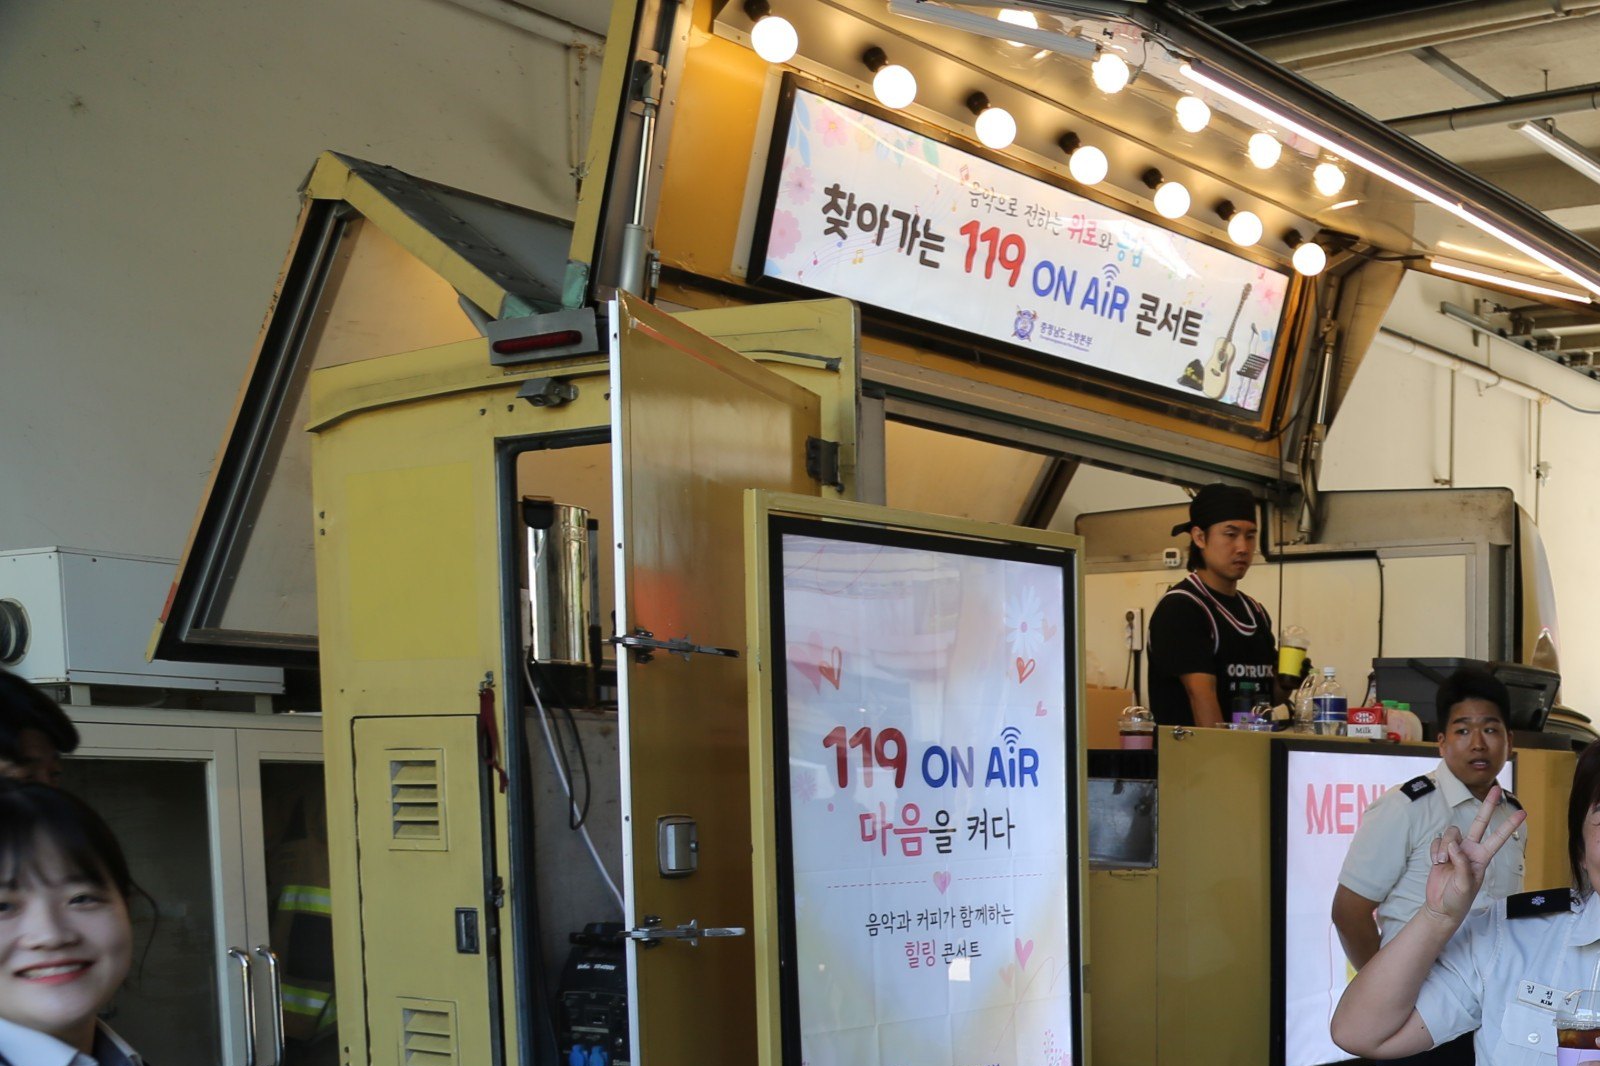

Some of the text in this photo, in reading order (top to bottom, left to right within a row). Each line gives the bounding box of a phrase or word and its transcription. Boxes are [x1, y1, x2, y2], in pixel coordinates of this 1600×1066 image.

[968, 181, 1018, 218] 음악으로
[1024, 203, 1063, 236] 전하는
[1067, 213, 1113, 252] 위로와
[822, 183, 946, 270] 찾아가는
[959, 219, 1026, 288] 119
[1032, 260, 1078, 306] ON
[1136, 293, 1204, 347] 콘서트
[822, 726, 908, 789] 119
[921, 745, 974, 788] ON
[859, 801, 1016, 857] 마음을 켜다
[1306, 783, 1387, 835] MEN
[865, 902, 1014, 937] 음악과 커피가 함께하는
[904, 939, 982, 969] 힐링 콘서트
